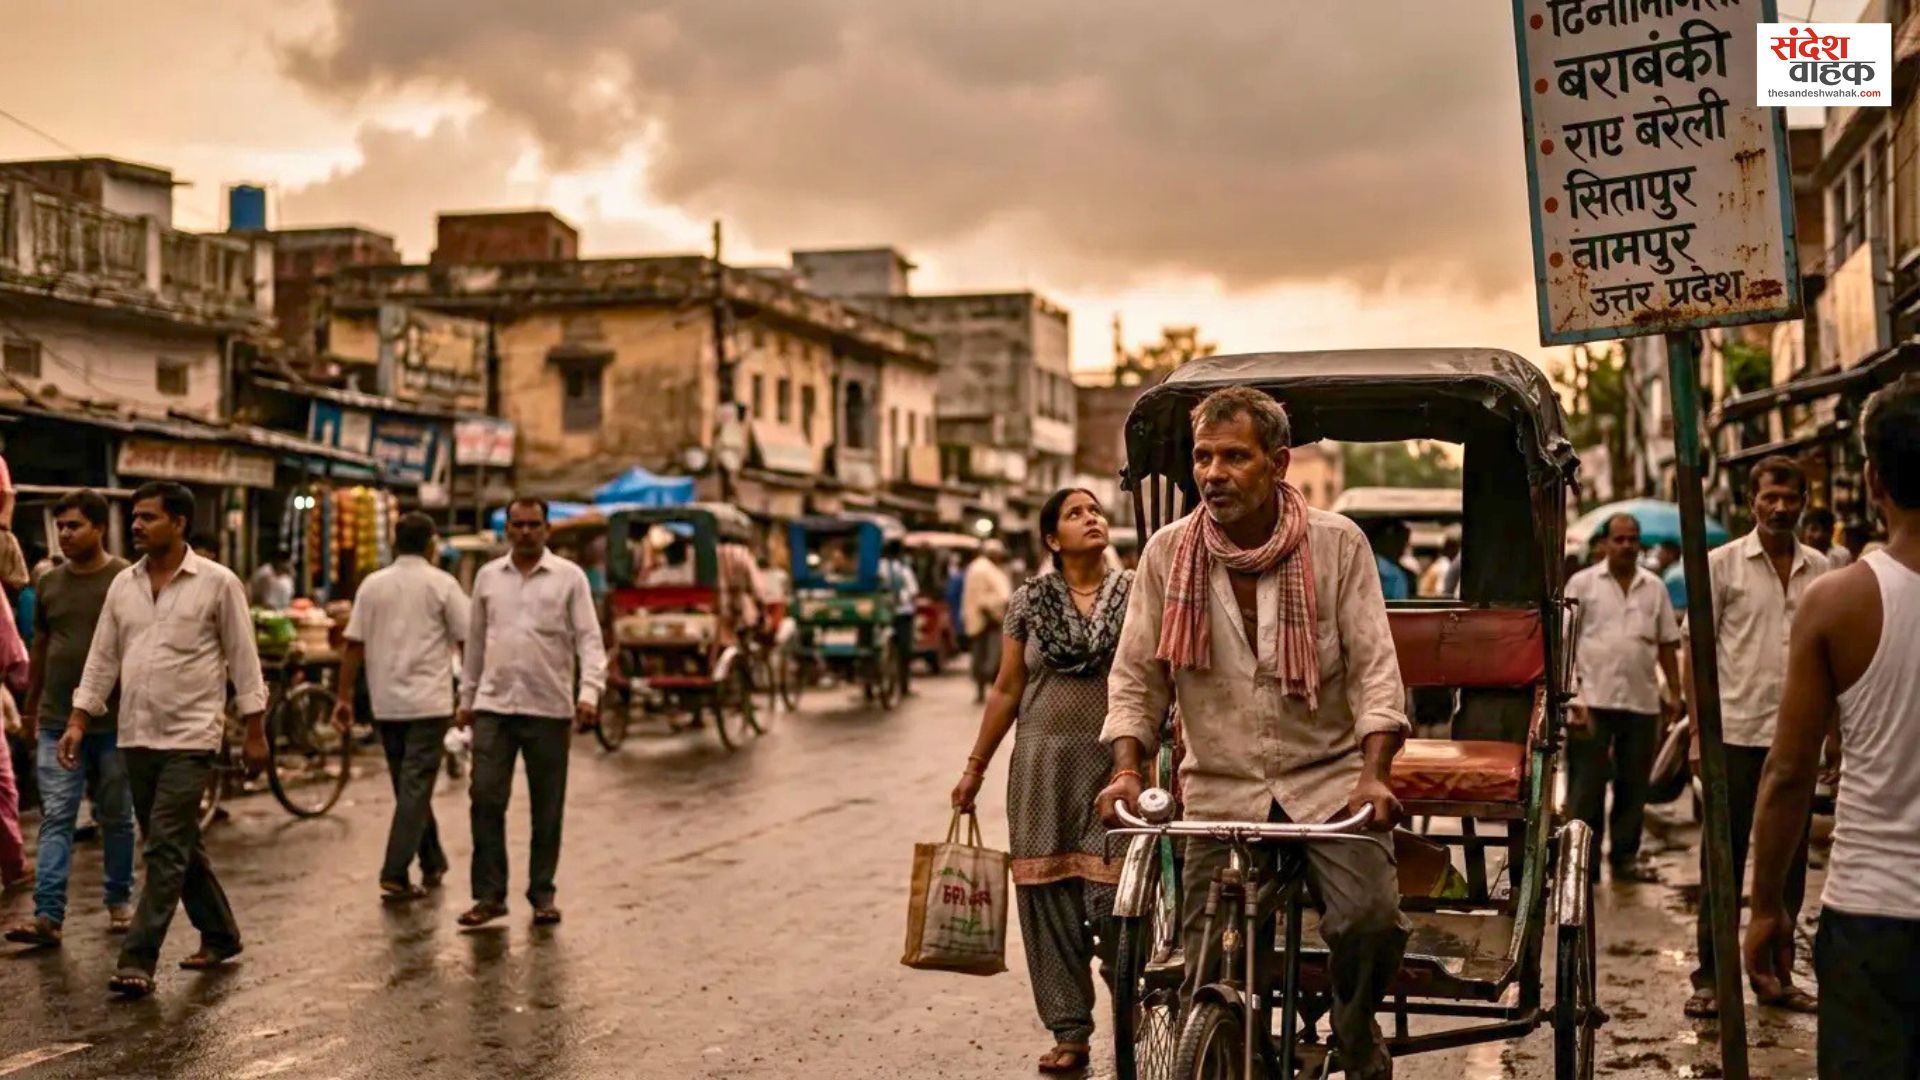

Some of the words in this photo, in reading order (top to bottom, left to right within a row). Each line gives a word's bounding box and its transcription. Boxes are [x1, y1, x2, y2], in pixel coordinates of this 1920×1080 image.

[1554, 19, 1732, 101] बराबंकी
[1562, 116, 1624, 163] राए
[1633, 88, 1730, 149] बरेली
[1563, 166, 1697, 220] सितापुर
[1664, 265, 1745, 307] प्रदेश
